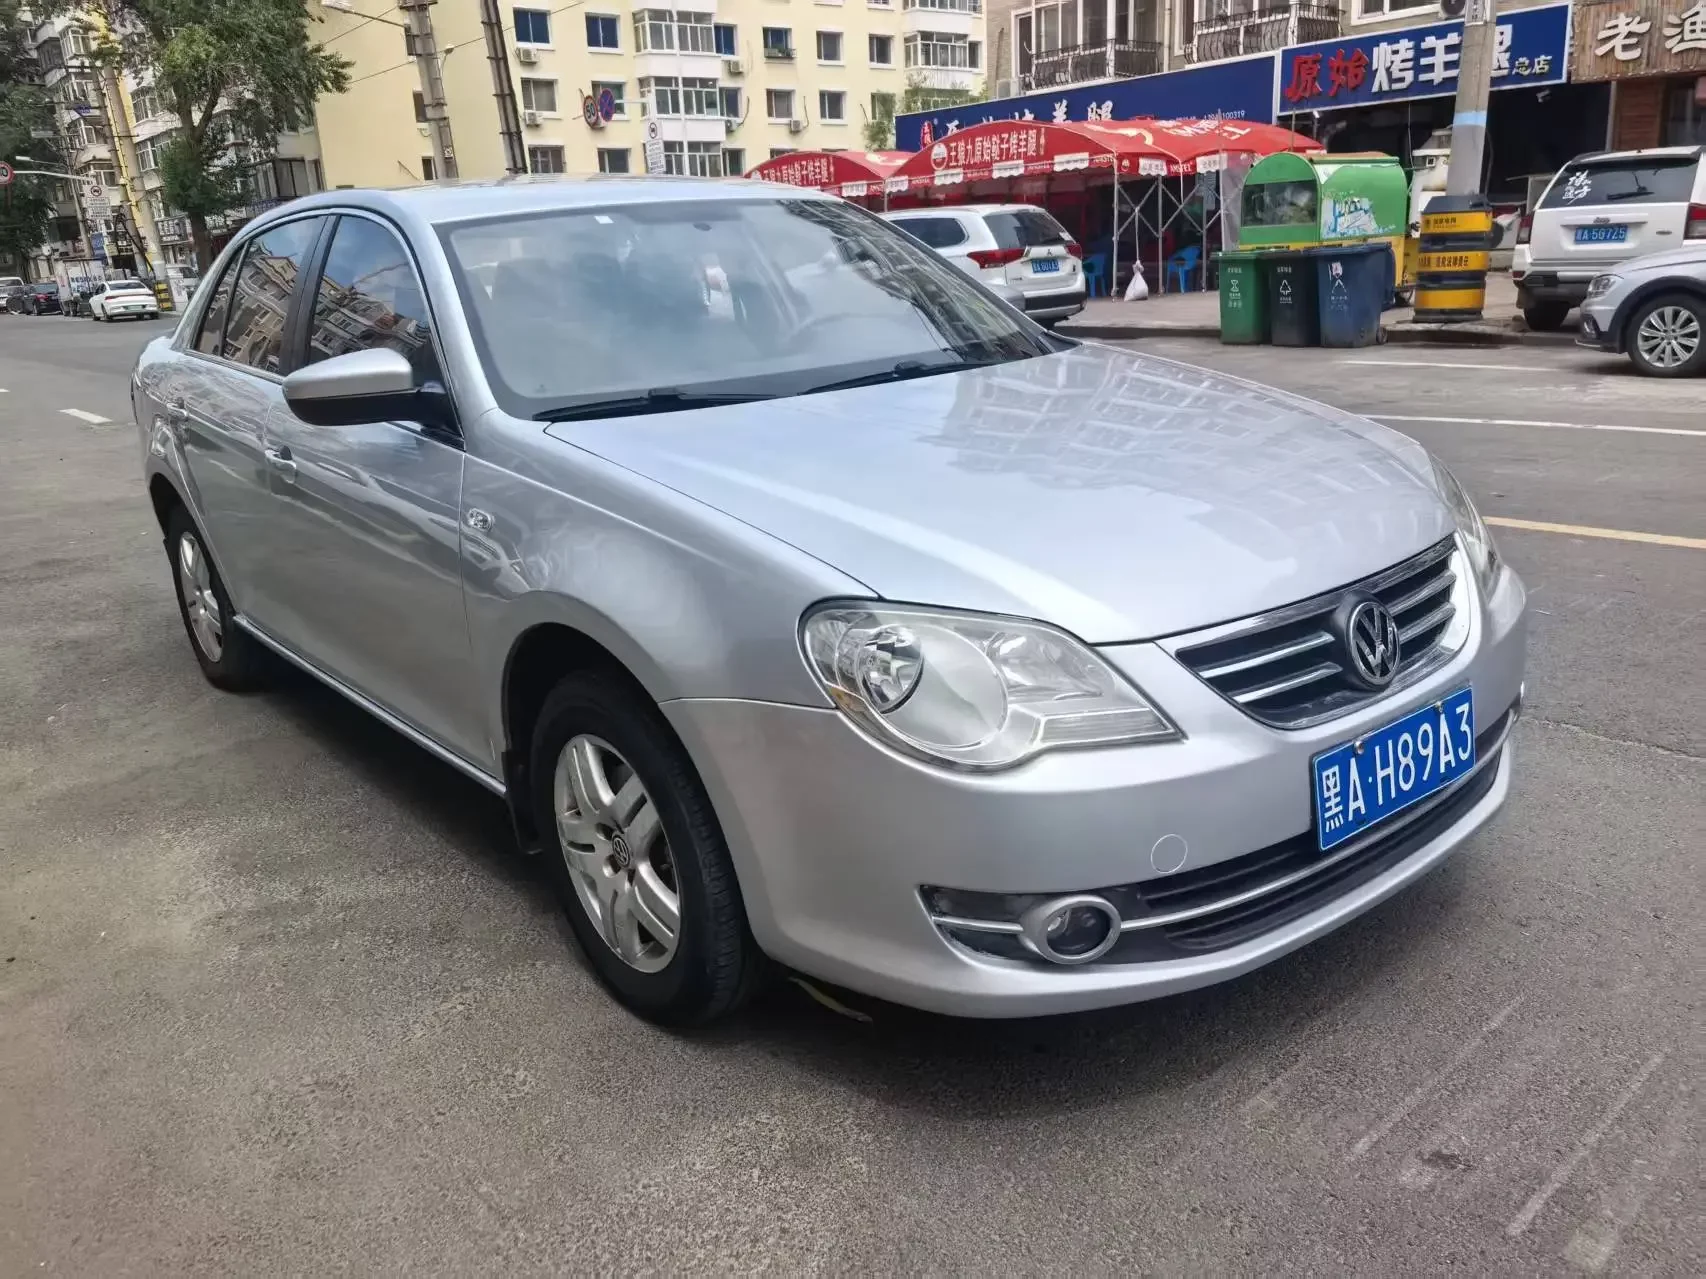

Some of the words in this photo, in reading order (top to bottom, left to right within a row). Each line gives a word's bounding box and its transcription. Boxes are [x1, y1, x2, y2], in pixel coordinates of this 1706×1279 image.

[1512, 55, 1553, 76] 总店
[585, 102, 596, 119] 50
[1321, 702, 1474, 833] 黑A·H89A3
